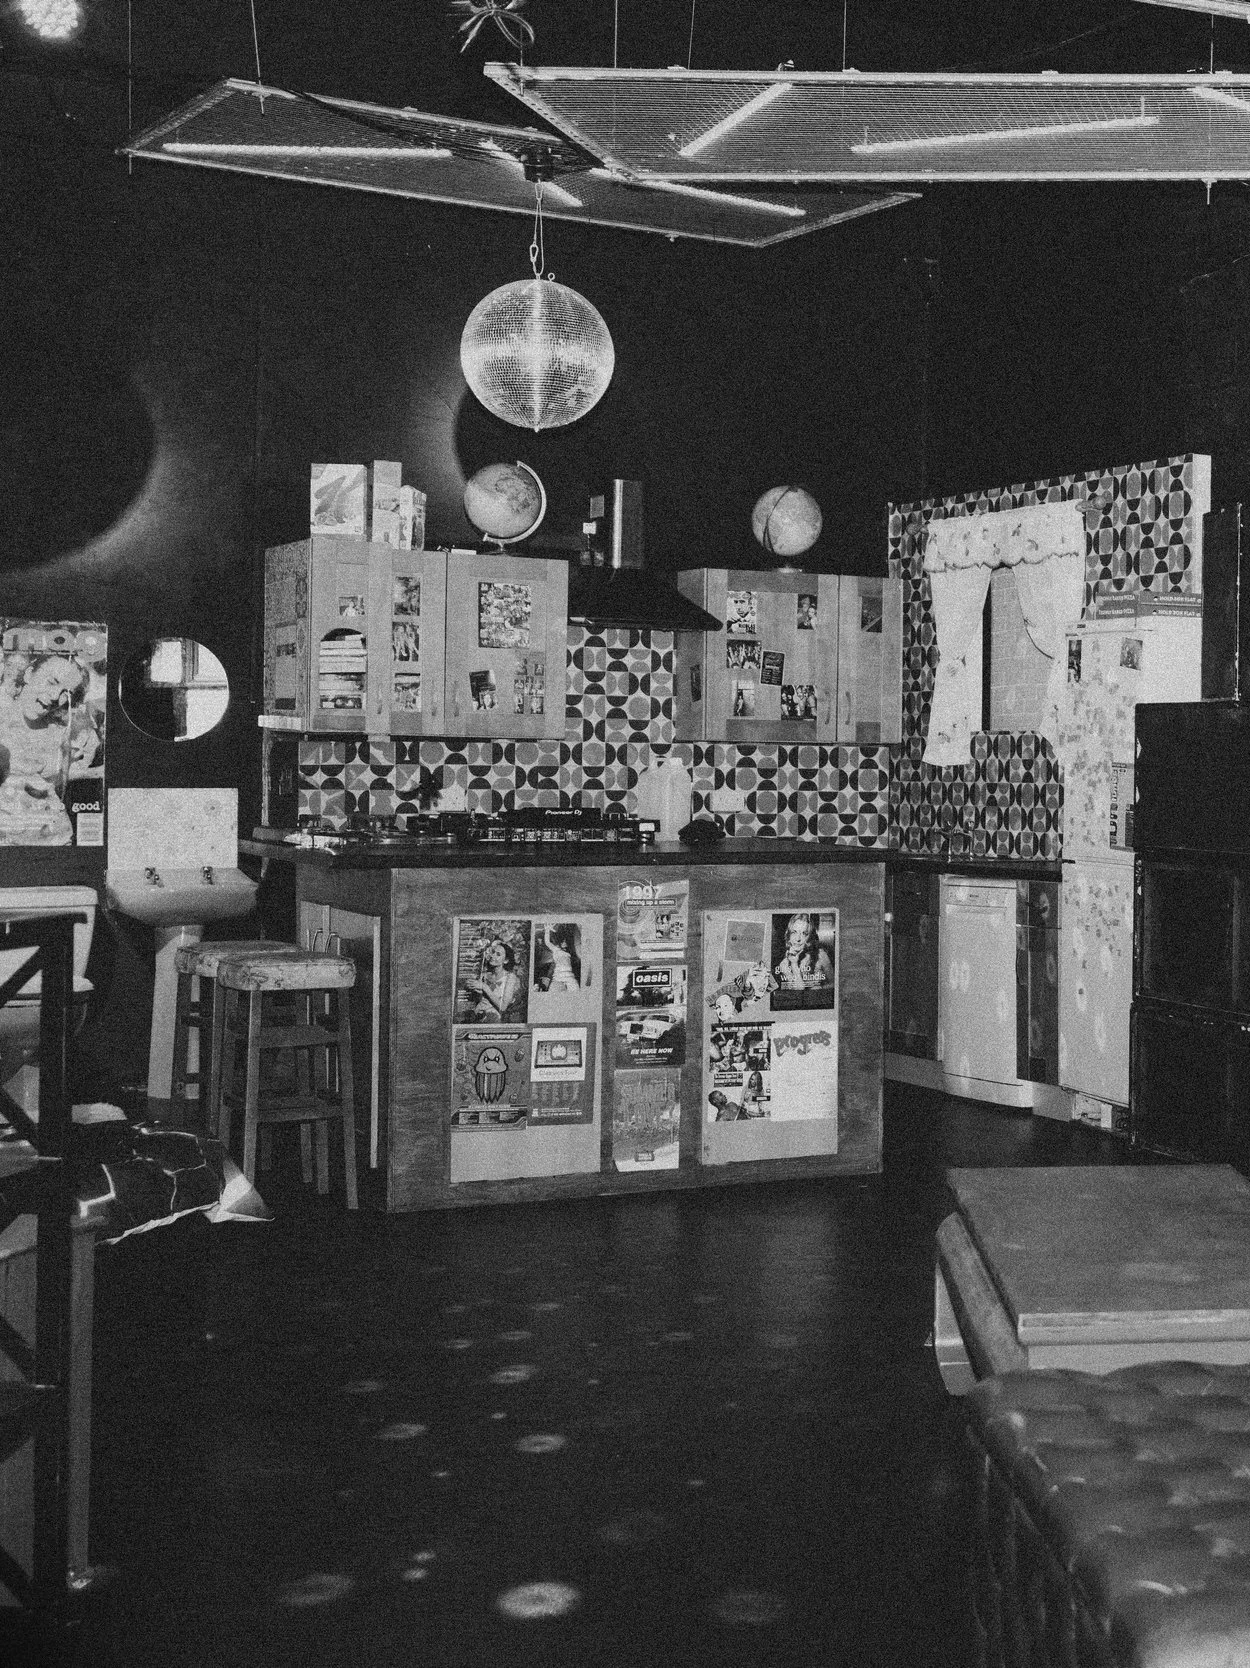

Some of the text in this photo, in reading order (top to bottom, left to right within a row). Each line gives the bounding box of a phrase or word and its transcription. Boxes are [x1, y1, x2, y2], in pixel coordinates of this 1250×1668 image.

[72, 801, 101, 812] good
[623, 885, 663, 899] 1997
[636, 972, 669, 983] oasis
[803, 972, 826, 981] bindis
